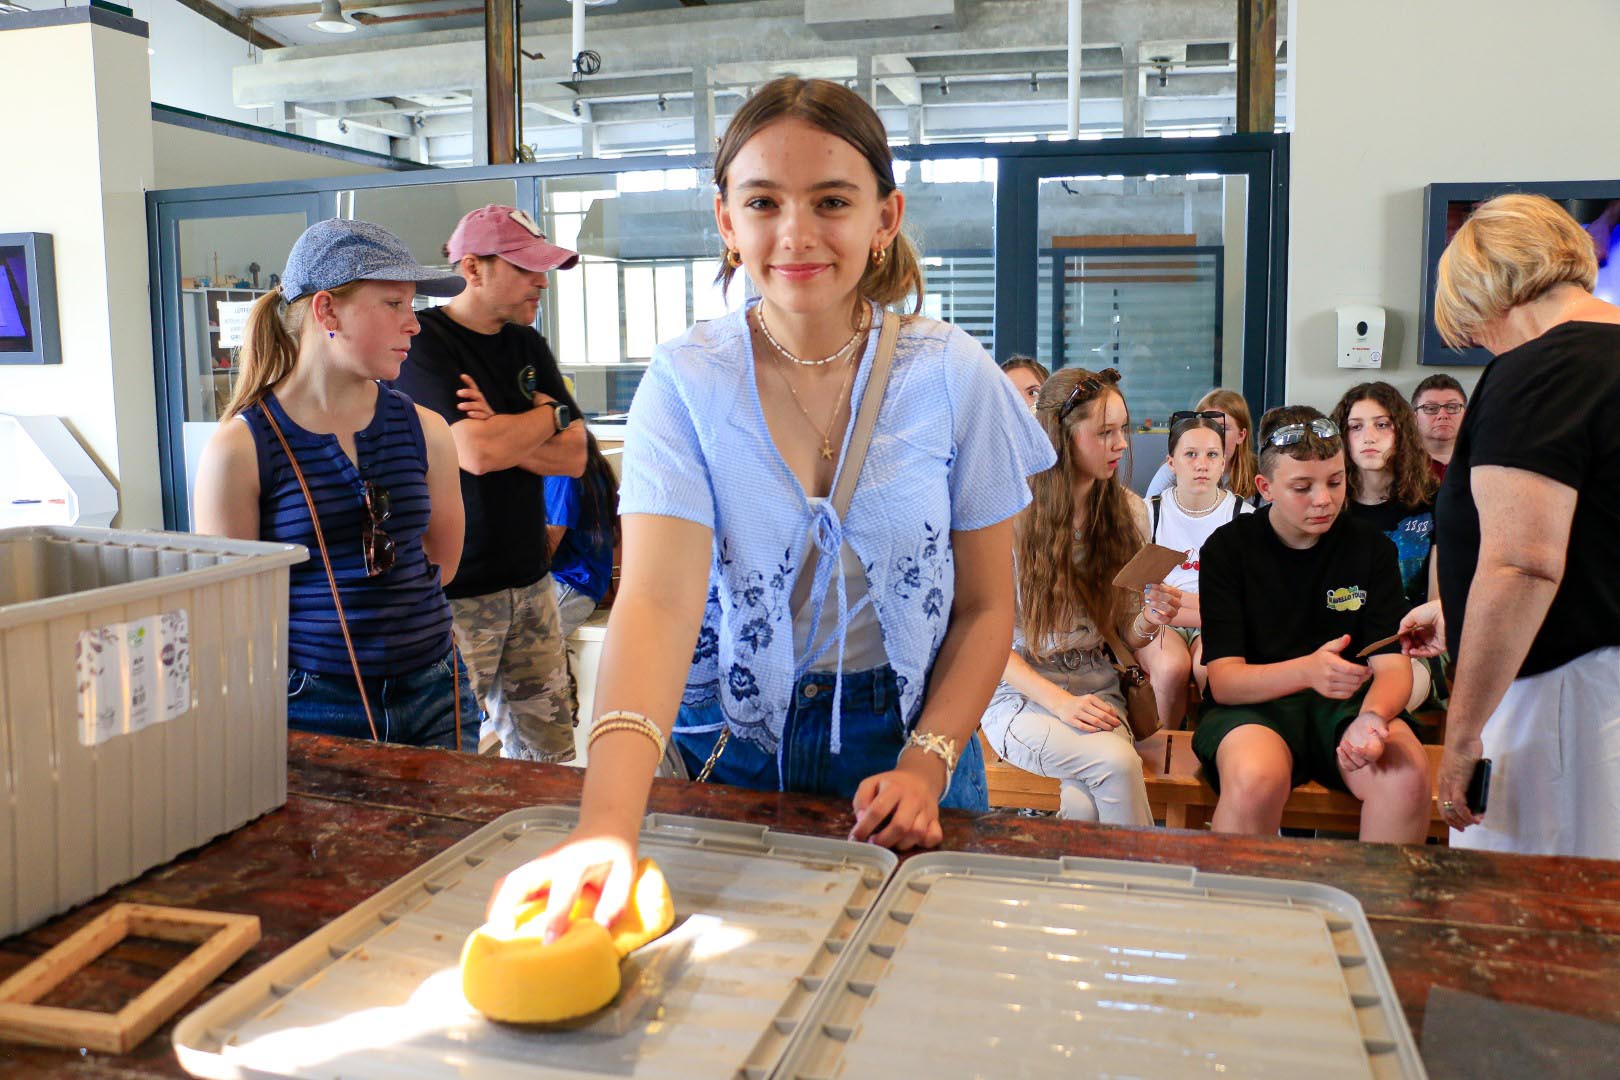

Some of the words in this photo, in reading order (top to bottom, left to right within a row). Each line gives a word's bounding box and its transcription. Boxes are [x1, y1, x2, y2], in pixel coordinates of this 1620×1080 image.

[1405, 520, 1429, 533] 1888
[1328, 594, 1352, 604] RAVELLO
[1352, 592, 1366, 600] TOUR
